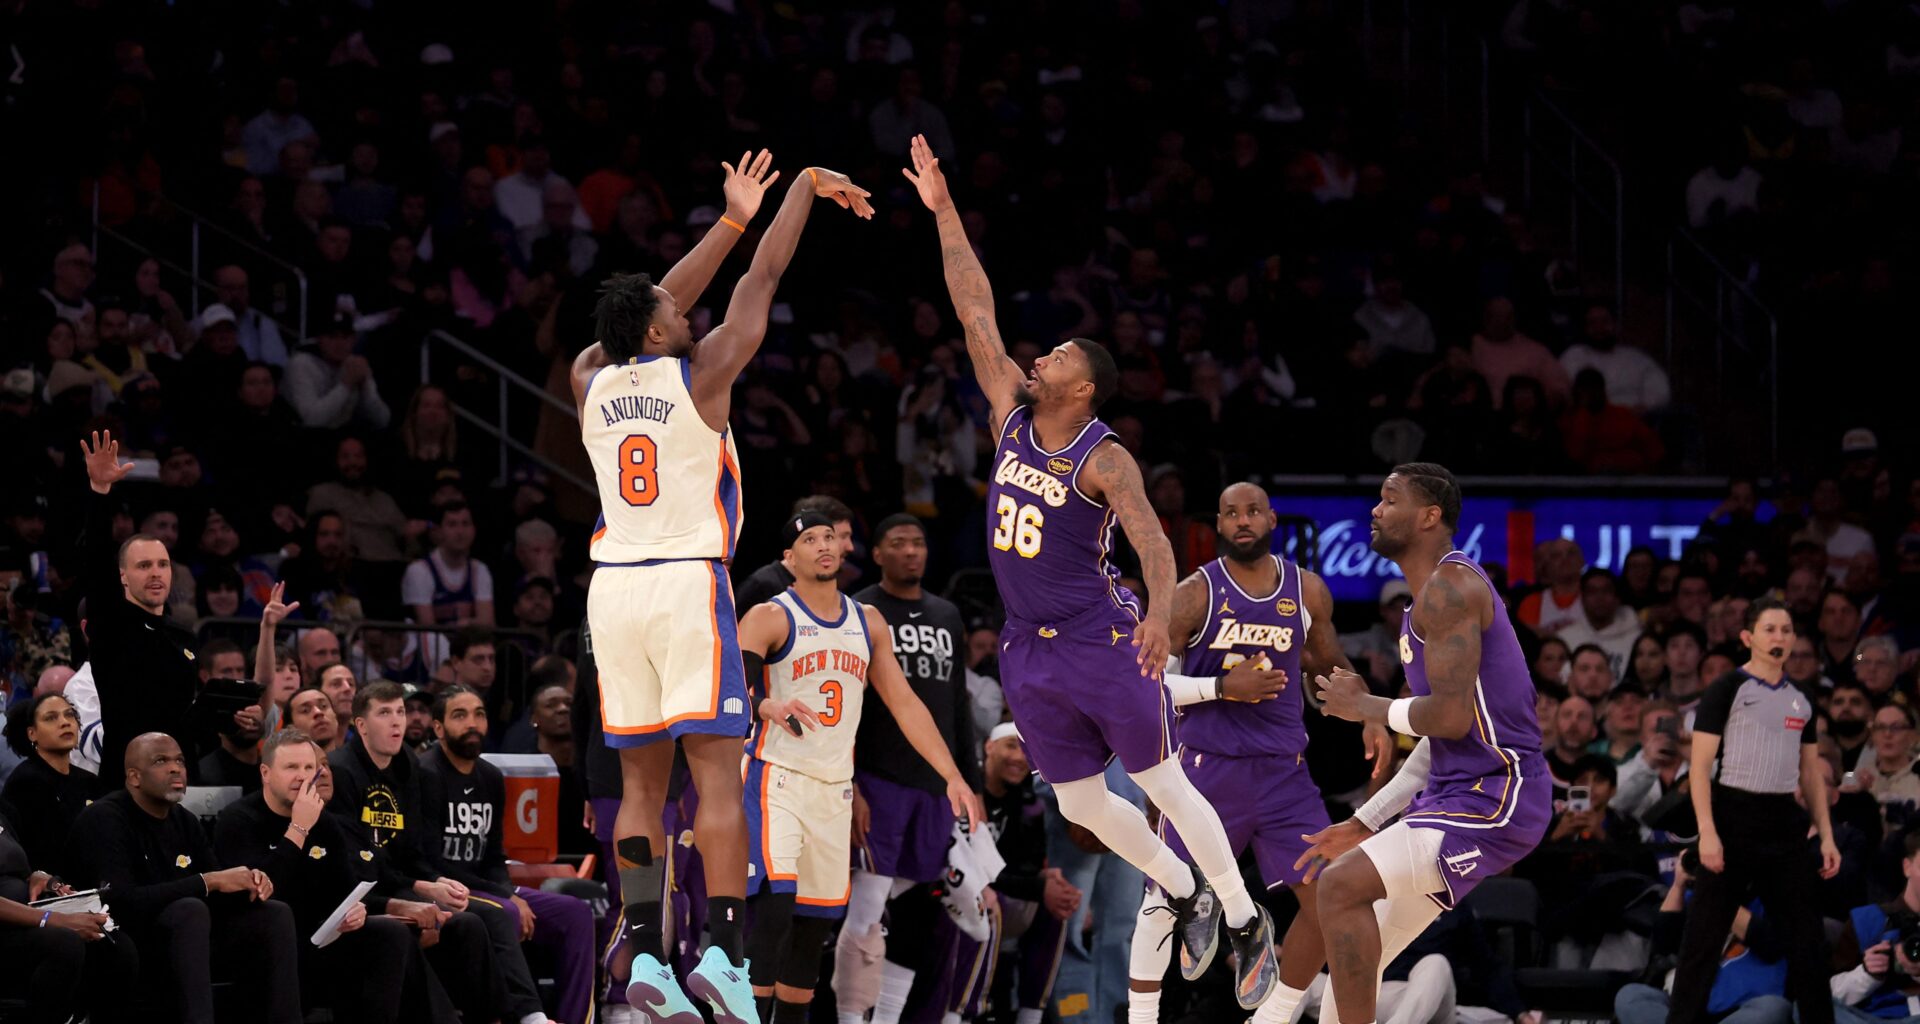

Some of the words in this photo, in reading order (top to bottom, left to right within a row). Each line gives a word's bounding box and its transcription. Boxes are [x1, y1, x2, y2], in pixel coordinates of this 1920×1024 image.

[600, 396, 676, 427] ANUNOBY
[618, 434, 660, 507] 8
[994, 449, 1070, 508] LAKERS
[993, 492, 1045, 559] 36
[888, 623, 954, 658] 1950
[1208, 618, 1294, 653] LAKERS
[792, 650, 828, 681] NEW
[916, 655, 932, 679] 8
[818, 680, 843, 727] 3
[444, 801, 494, 836] 1950
[516, 787, 538, 834] G
[464, 837, 475, 862] 8
